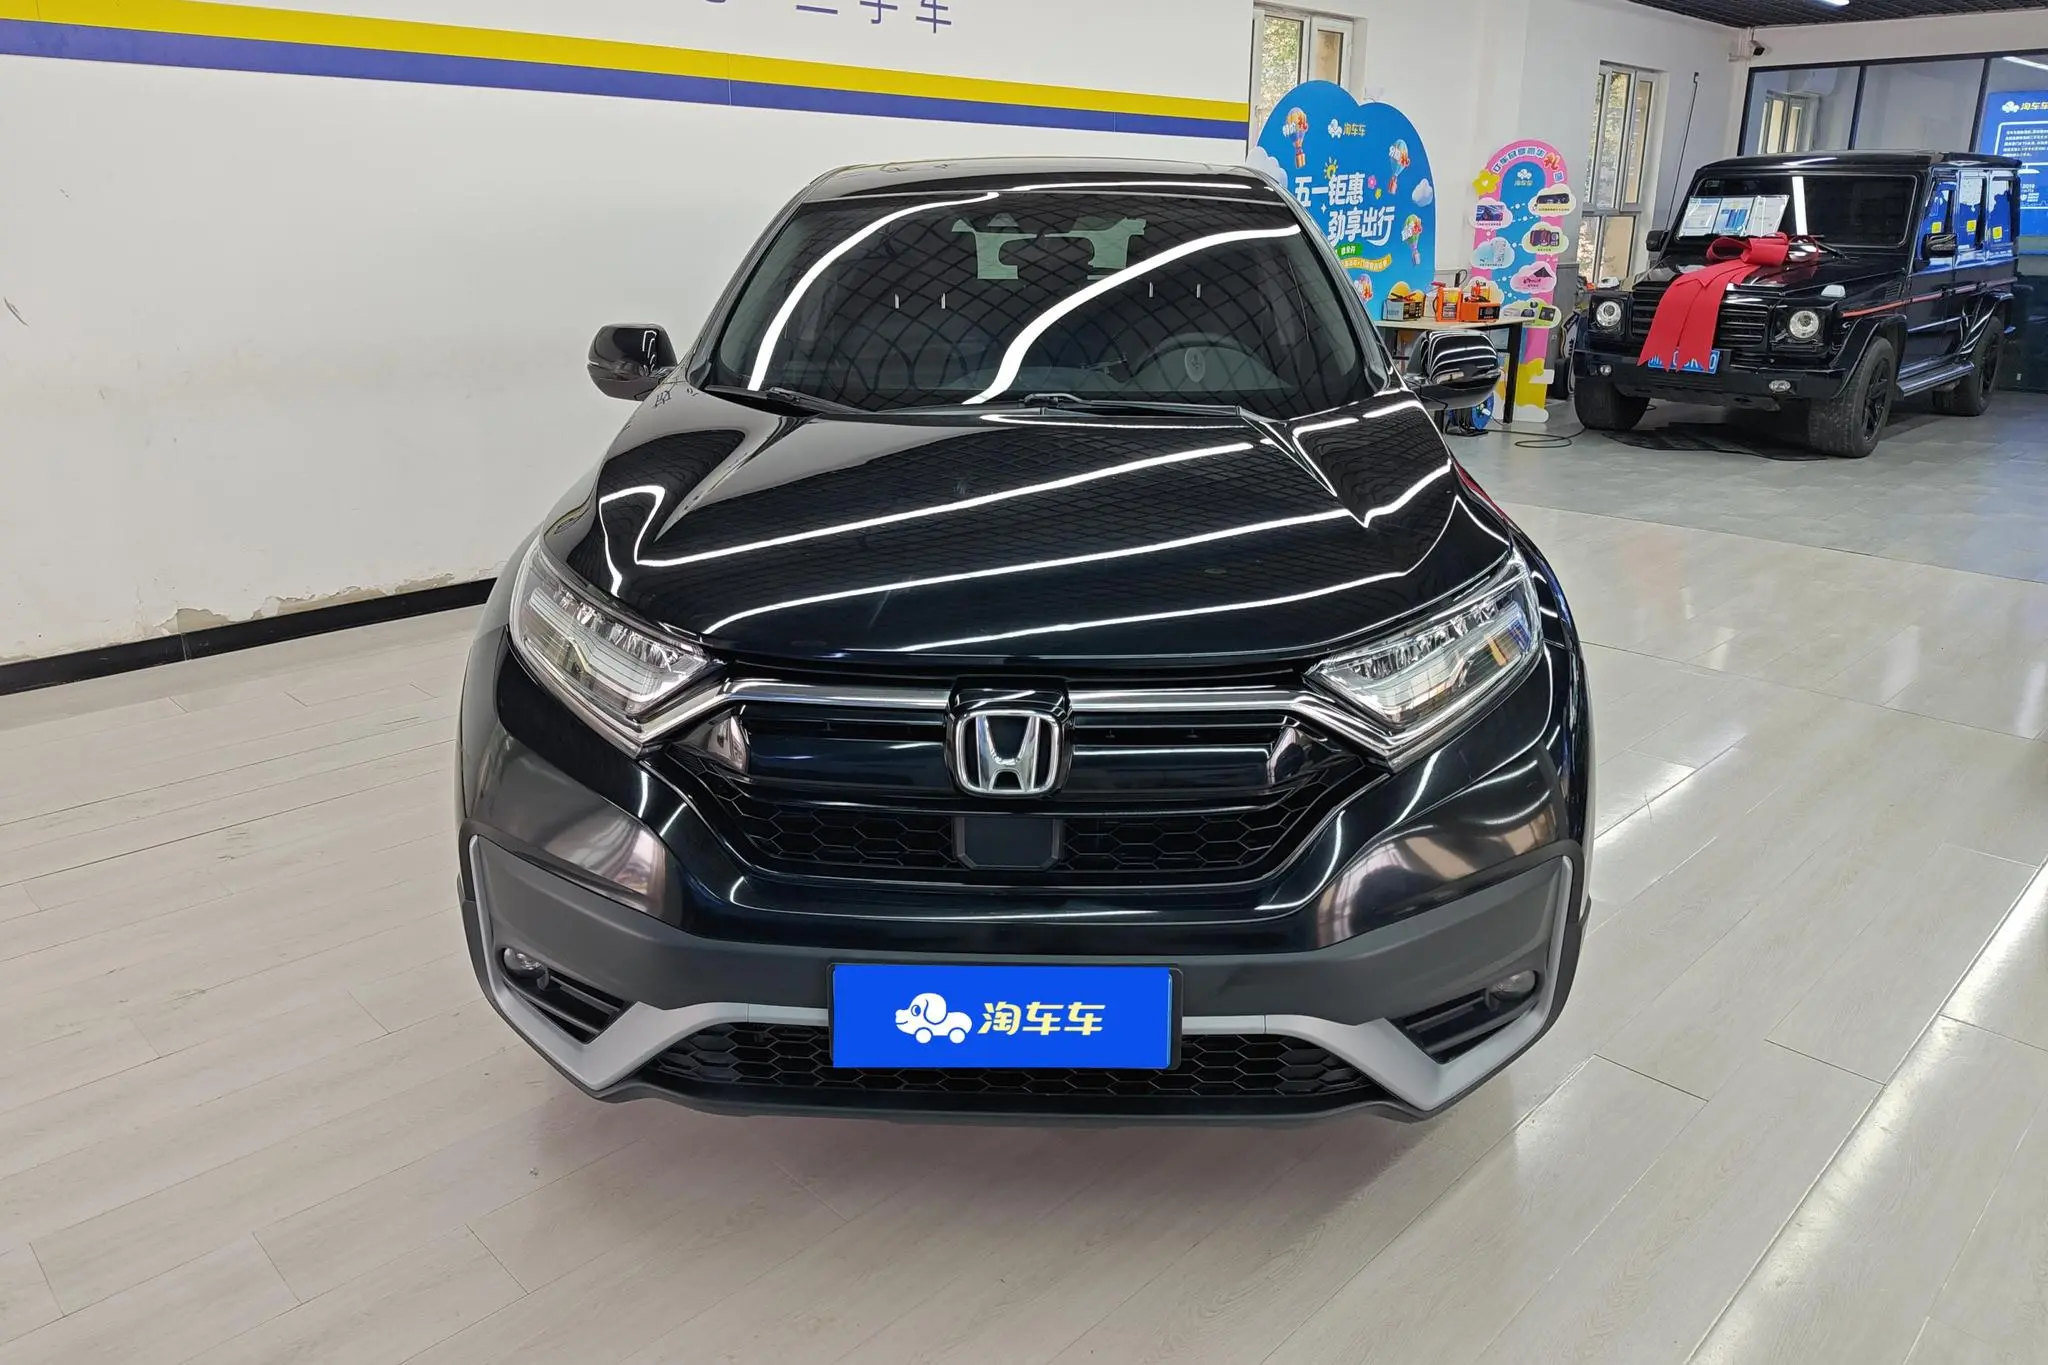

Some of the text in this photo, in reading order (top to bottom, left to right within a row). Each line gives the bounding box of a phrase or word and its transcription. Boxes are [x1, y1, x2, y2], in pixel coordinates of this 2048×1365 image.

[1294, 172, 1365, 207] 五一钜惠
[1327, 206, 1395, 249] 劲享出行
